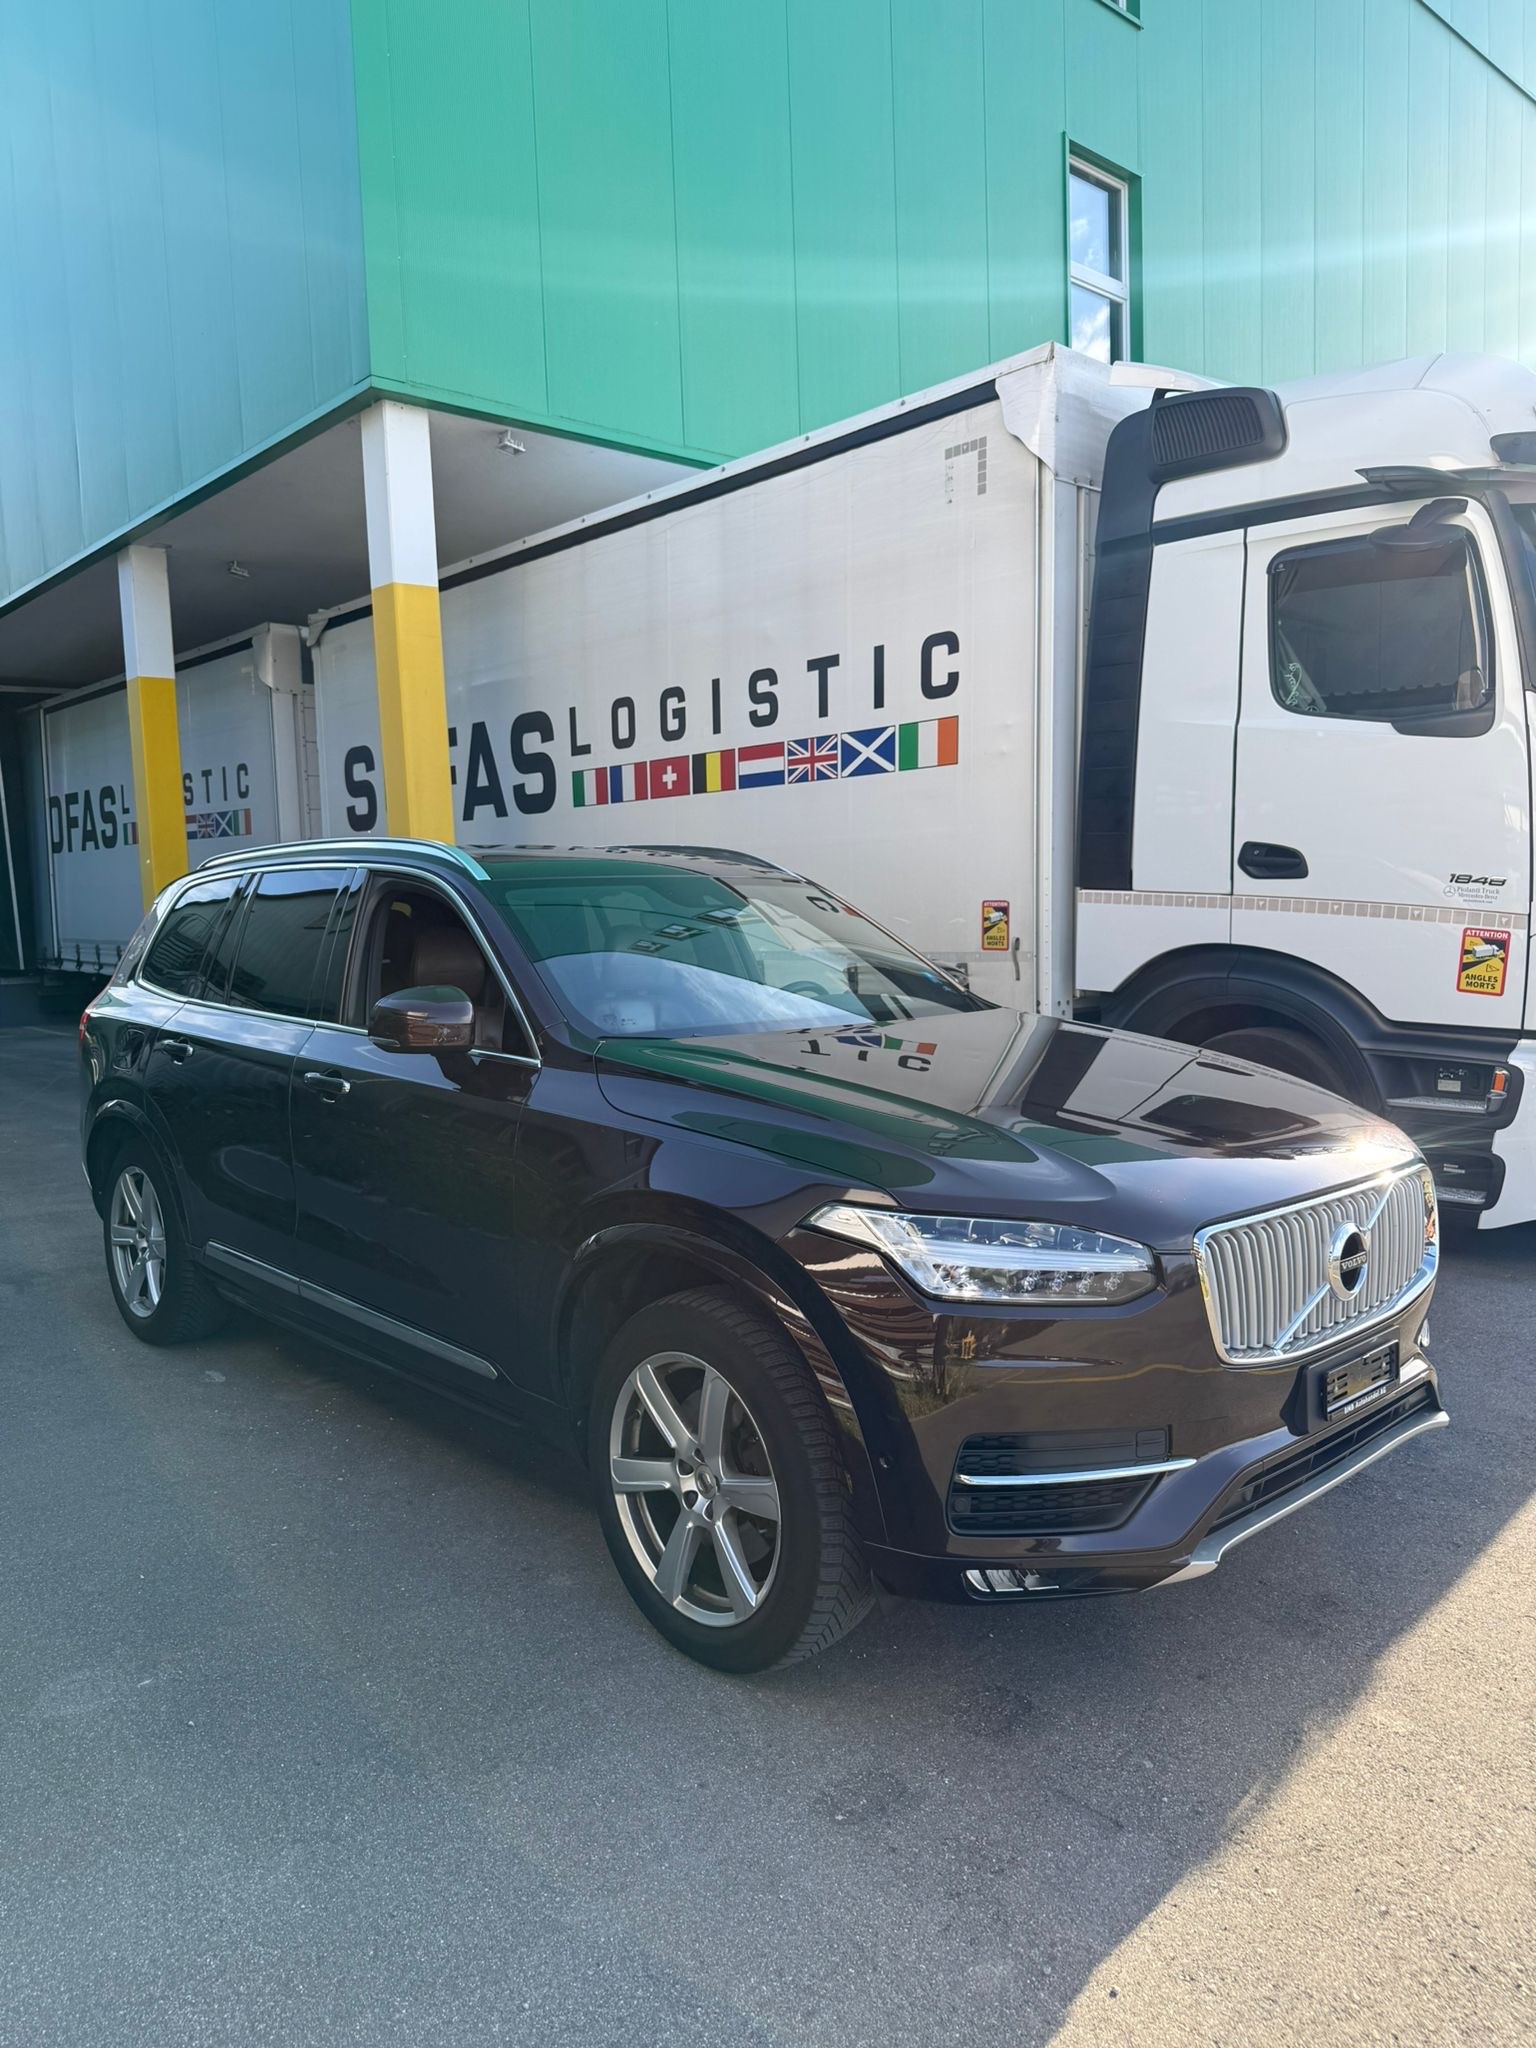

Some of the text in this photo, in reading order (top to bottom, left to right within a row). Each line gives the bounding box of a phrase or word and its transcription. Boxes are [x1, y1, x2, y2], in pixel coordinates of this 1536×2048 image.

[344, 630, 960, 832] SAS LOGISTIC
[120, 763, 250, 815] LSTIC
[1449, 873, 1507, 886] 1848
[1466, 929, 1509, 939] ATTENTION
[1464, 973, 1499, 983] ANGLES
[1465, 981, 1496, 990] MORTS
[1341, 1254, 1367, 1270] VOLVO
